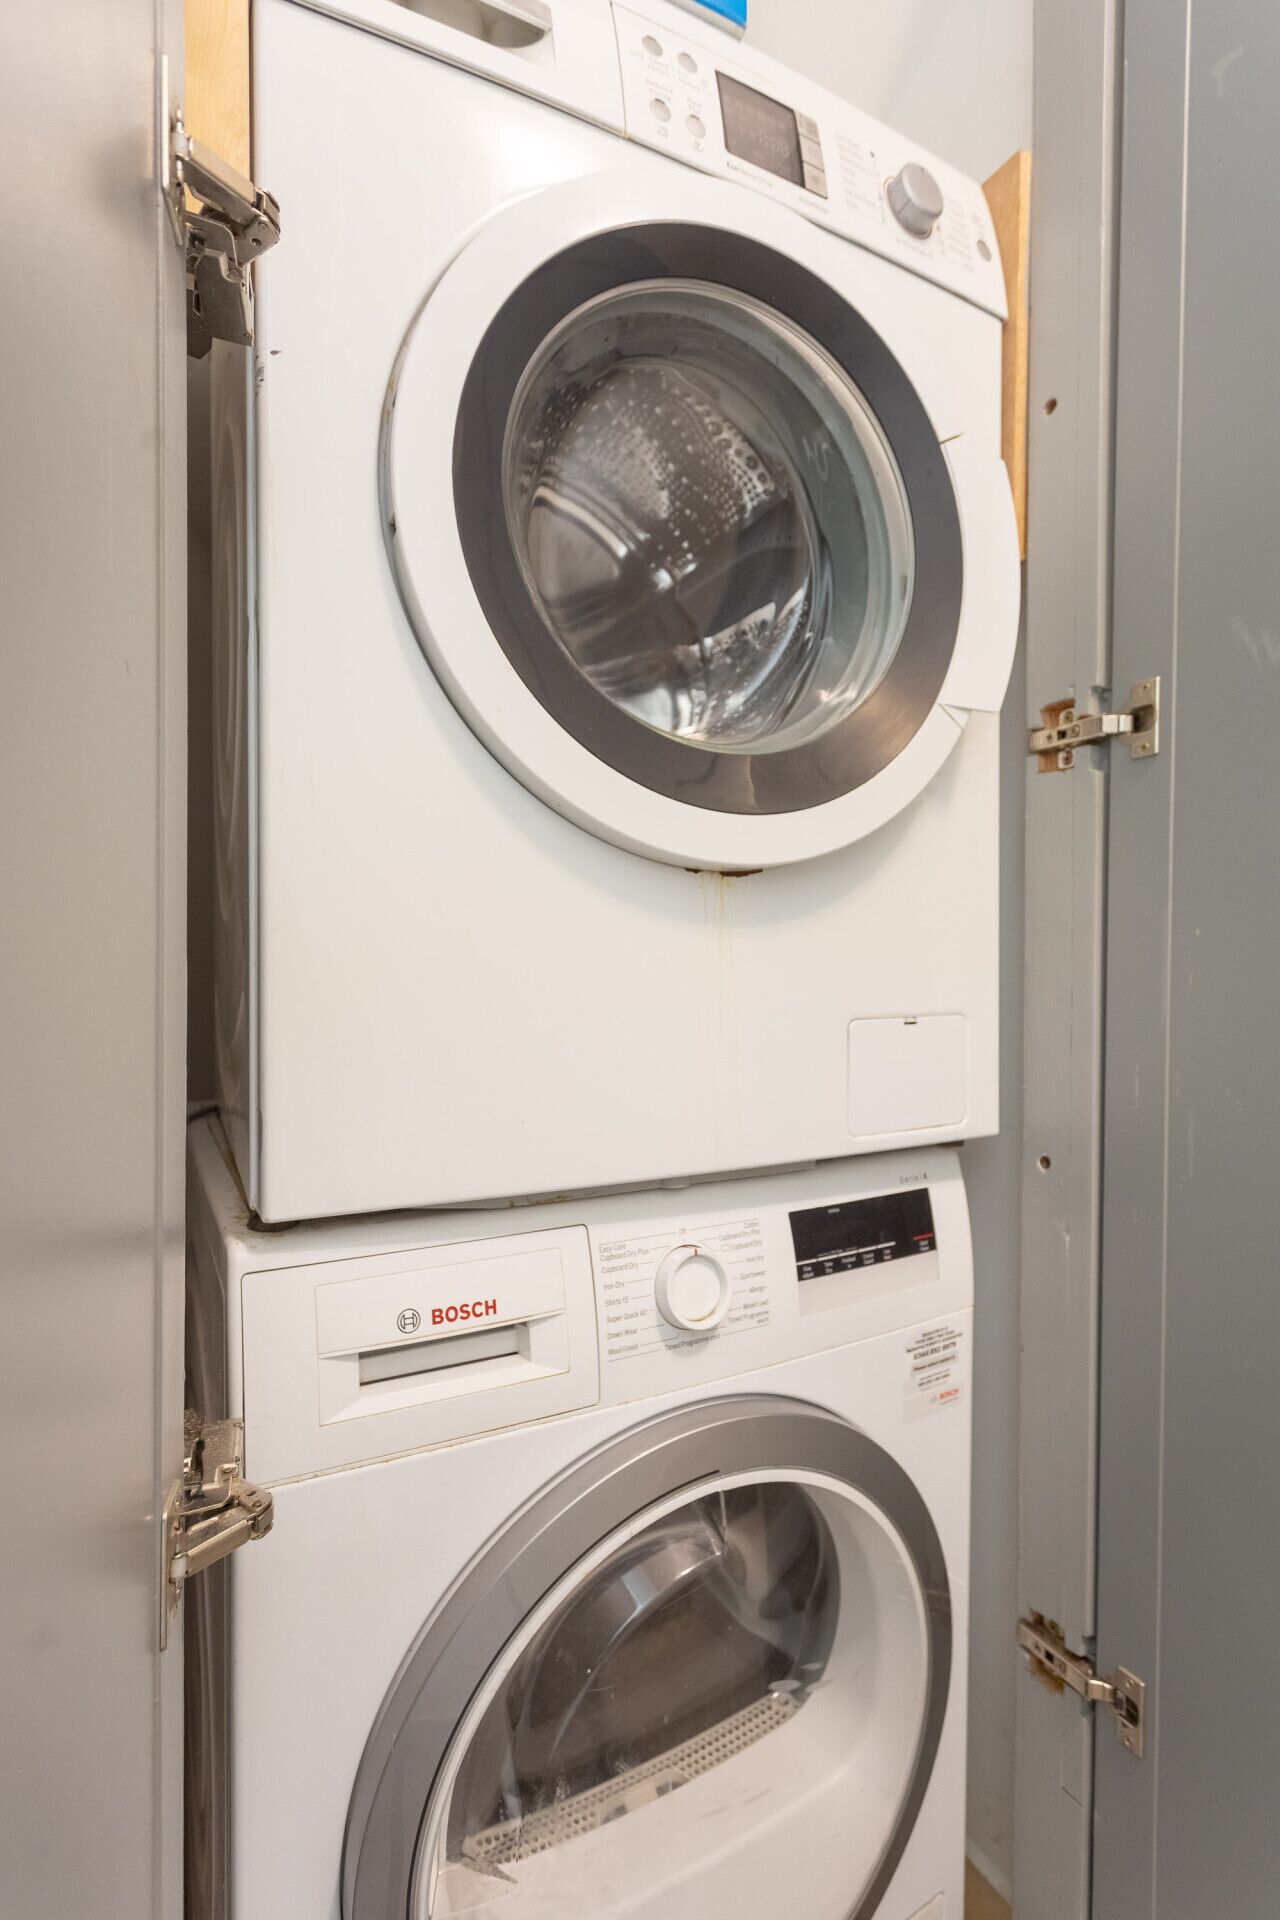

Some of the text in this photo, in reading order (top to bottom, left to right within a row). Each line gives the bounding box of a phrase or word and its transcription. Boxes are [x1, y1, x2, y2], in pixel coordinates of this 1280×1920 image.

[598, 1243, 626, 1255] Easy-Care
[599, 1247, 650, 1263] Cupboard Dry Plus
[600, 1261, 639, 1274] Cupboard Dry
[603, 1281, 625, 1290] Iron Dry
[605, 1297, 622, 1307] Shirts
[431, 1299, 497, 1325] BOSCH
[606, 1314, 622, 1323] Super
[623, 1310, 639, 1321] Quick
[607, 1328, 638, 1340] Down Wear
[608, 1343, 639, 1356] Wool Finish
